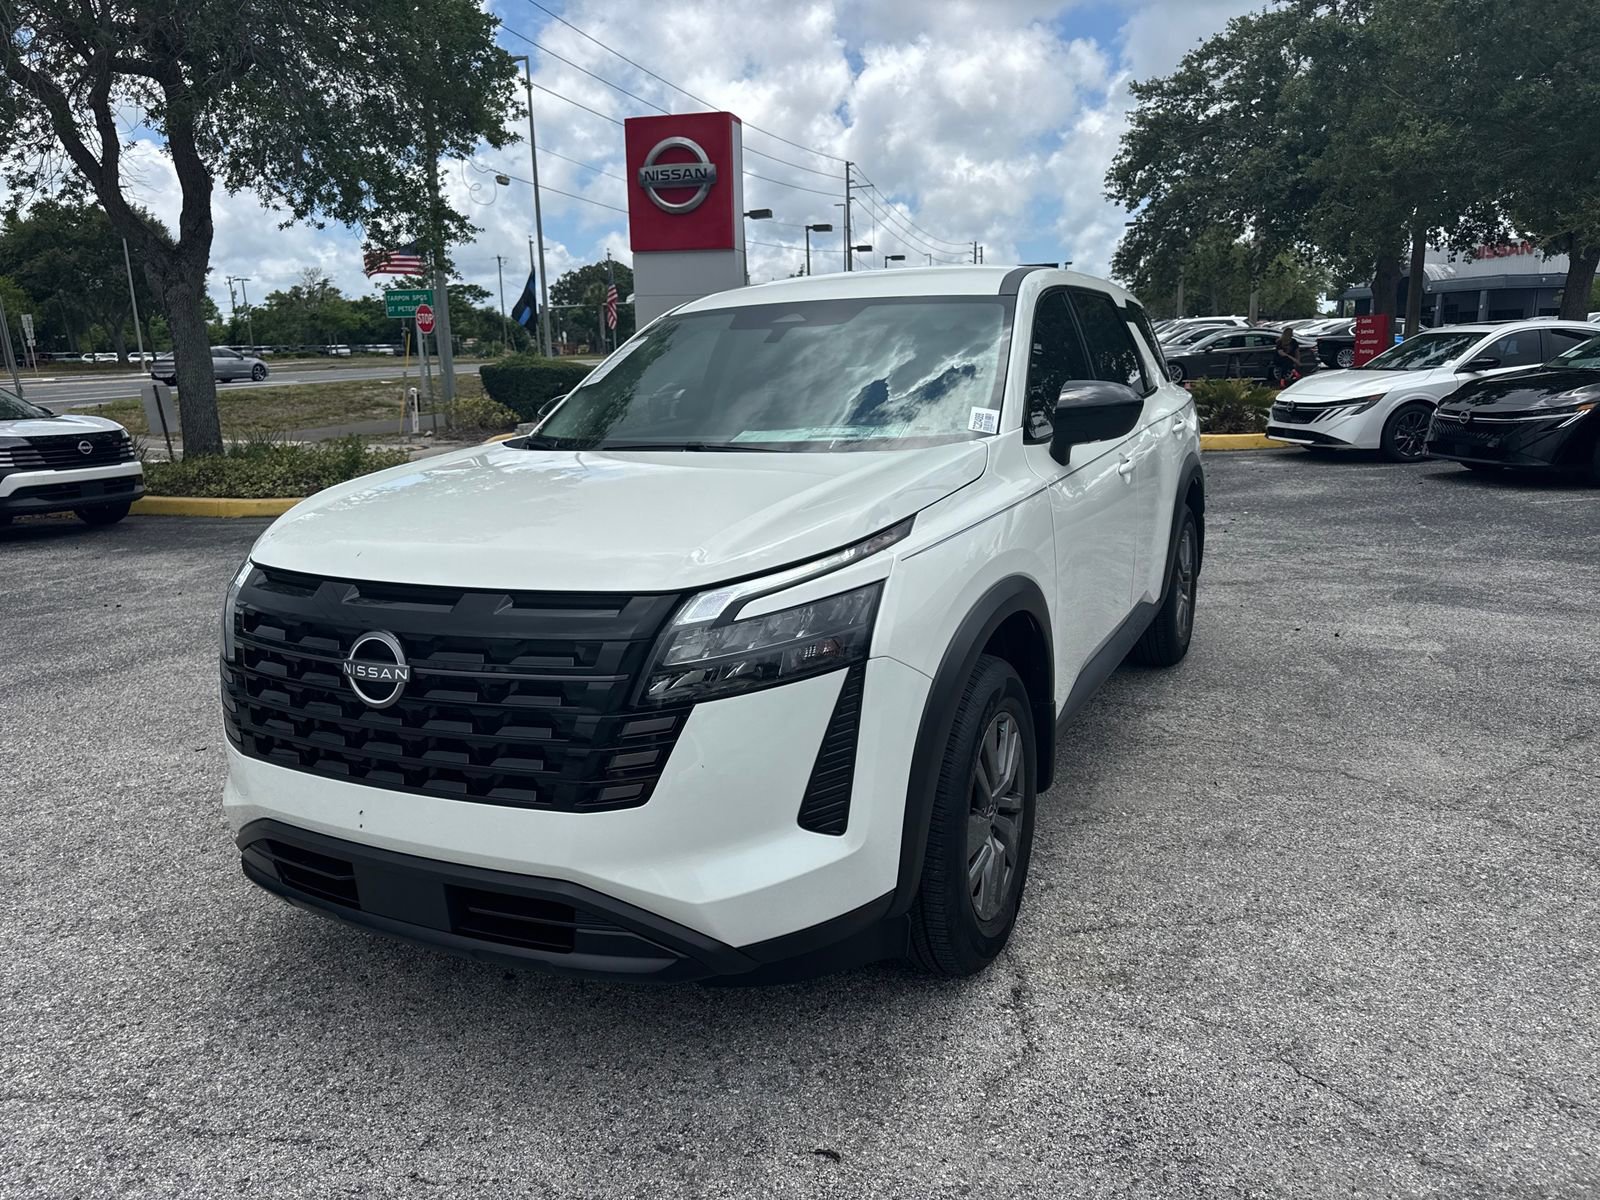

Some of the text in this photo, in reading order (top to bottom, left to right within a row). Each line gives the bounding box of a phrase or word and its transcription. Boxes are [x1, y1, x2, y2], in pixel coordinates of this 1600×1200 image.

[644, 167, 707, 182] NISSAN
[417, 313, 434, 325] STOP
[343, 661, 408, 680] NISSAN
